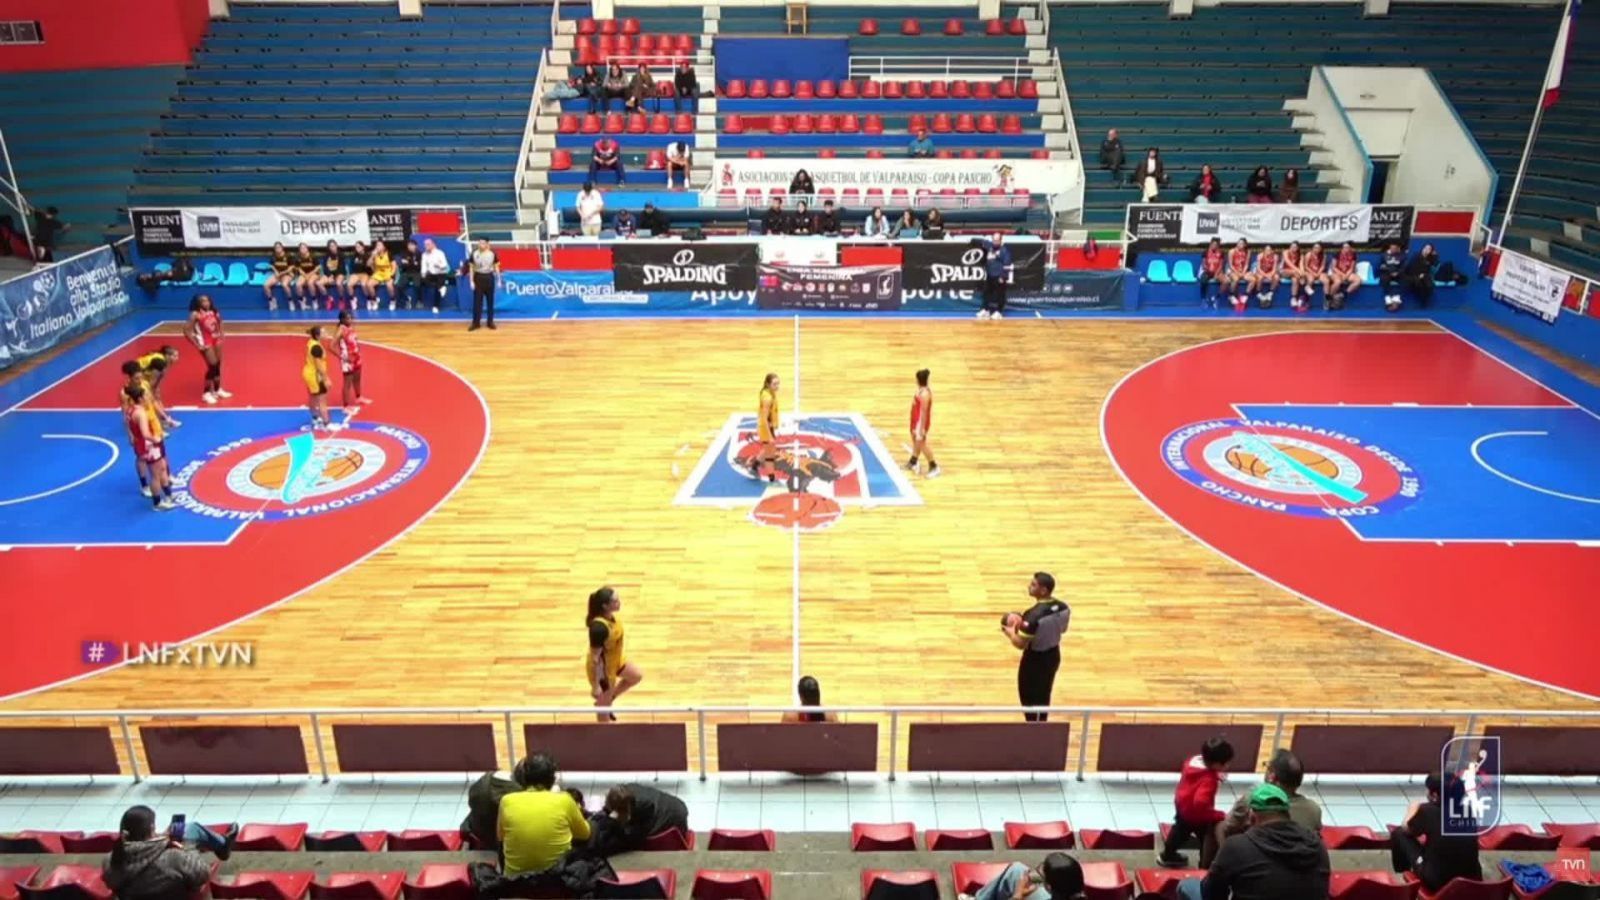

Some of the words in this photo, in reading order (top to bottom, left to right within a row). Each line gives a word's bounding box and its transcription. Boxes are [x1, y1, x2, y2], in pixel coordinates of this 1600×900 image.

[933, 171, 956, 184] COPA
[280, 219, 356, 235] DEPORTES
[1280, 215, 1358, 231] DEPORTES
[643, 264, 727, 286] SPALDING
[30, 312, 74, 339] Italiano
